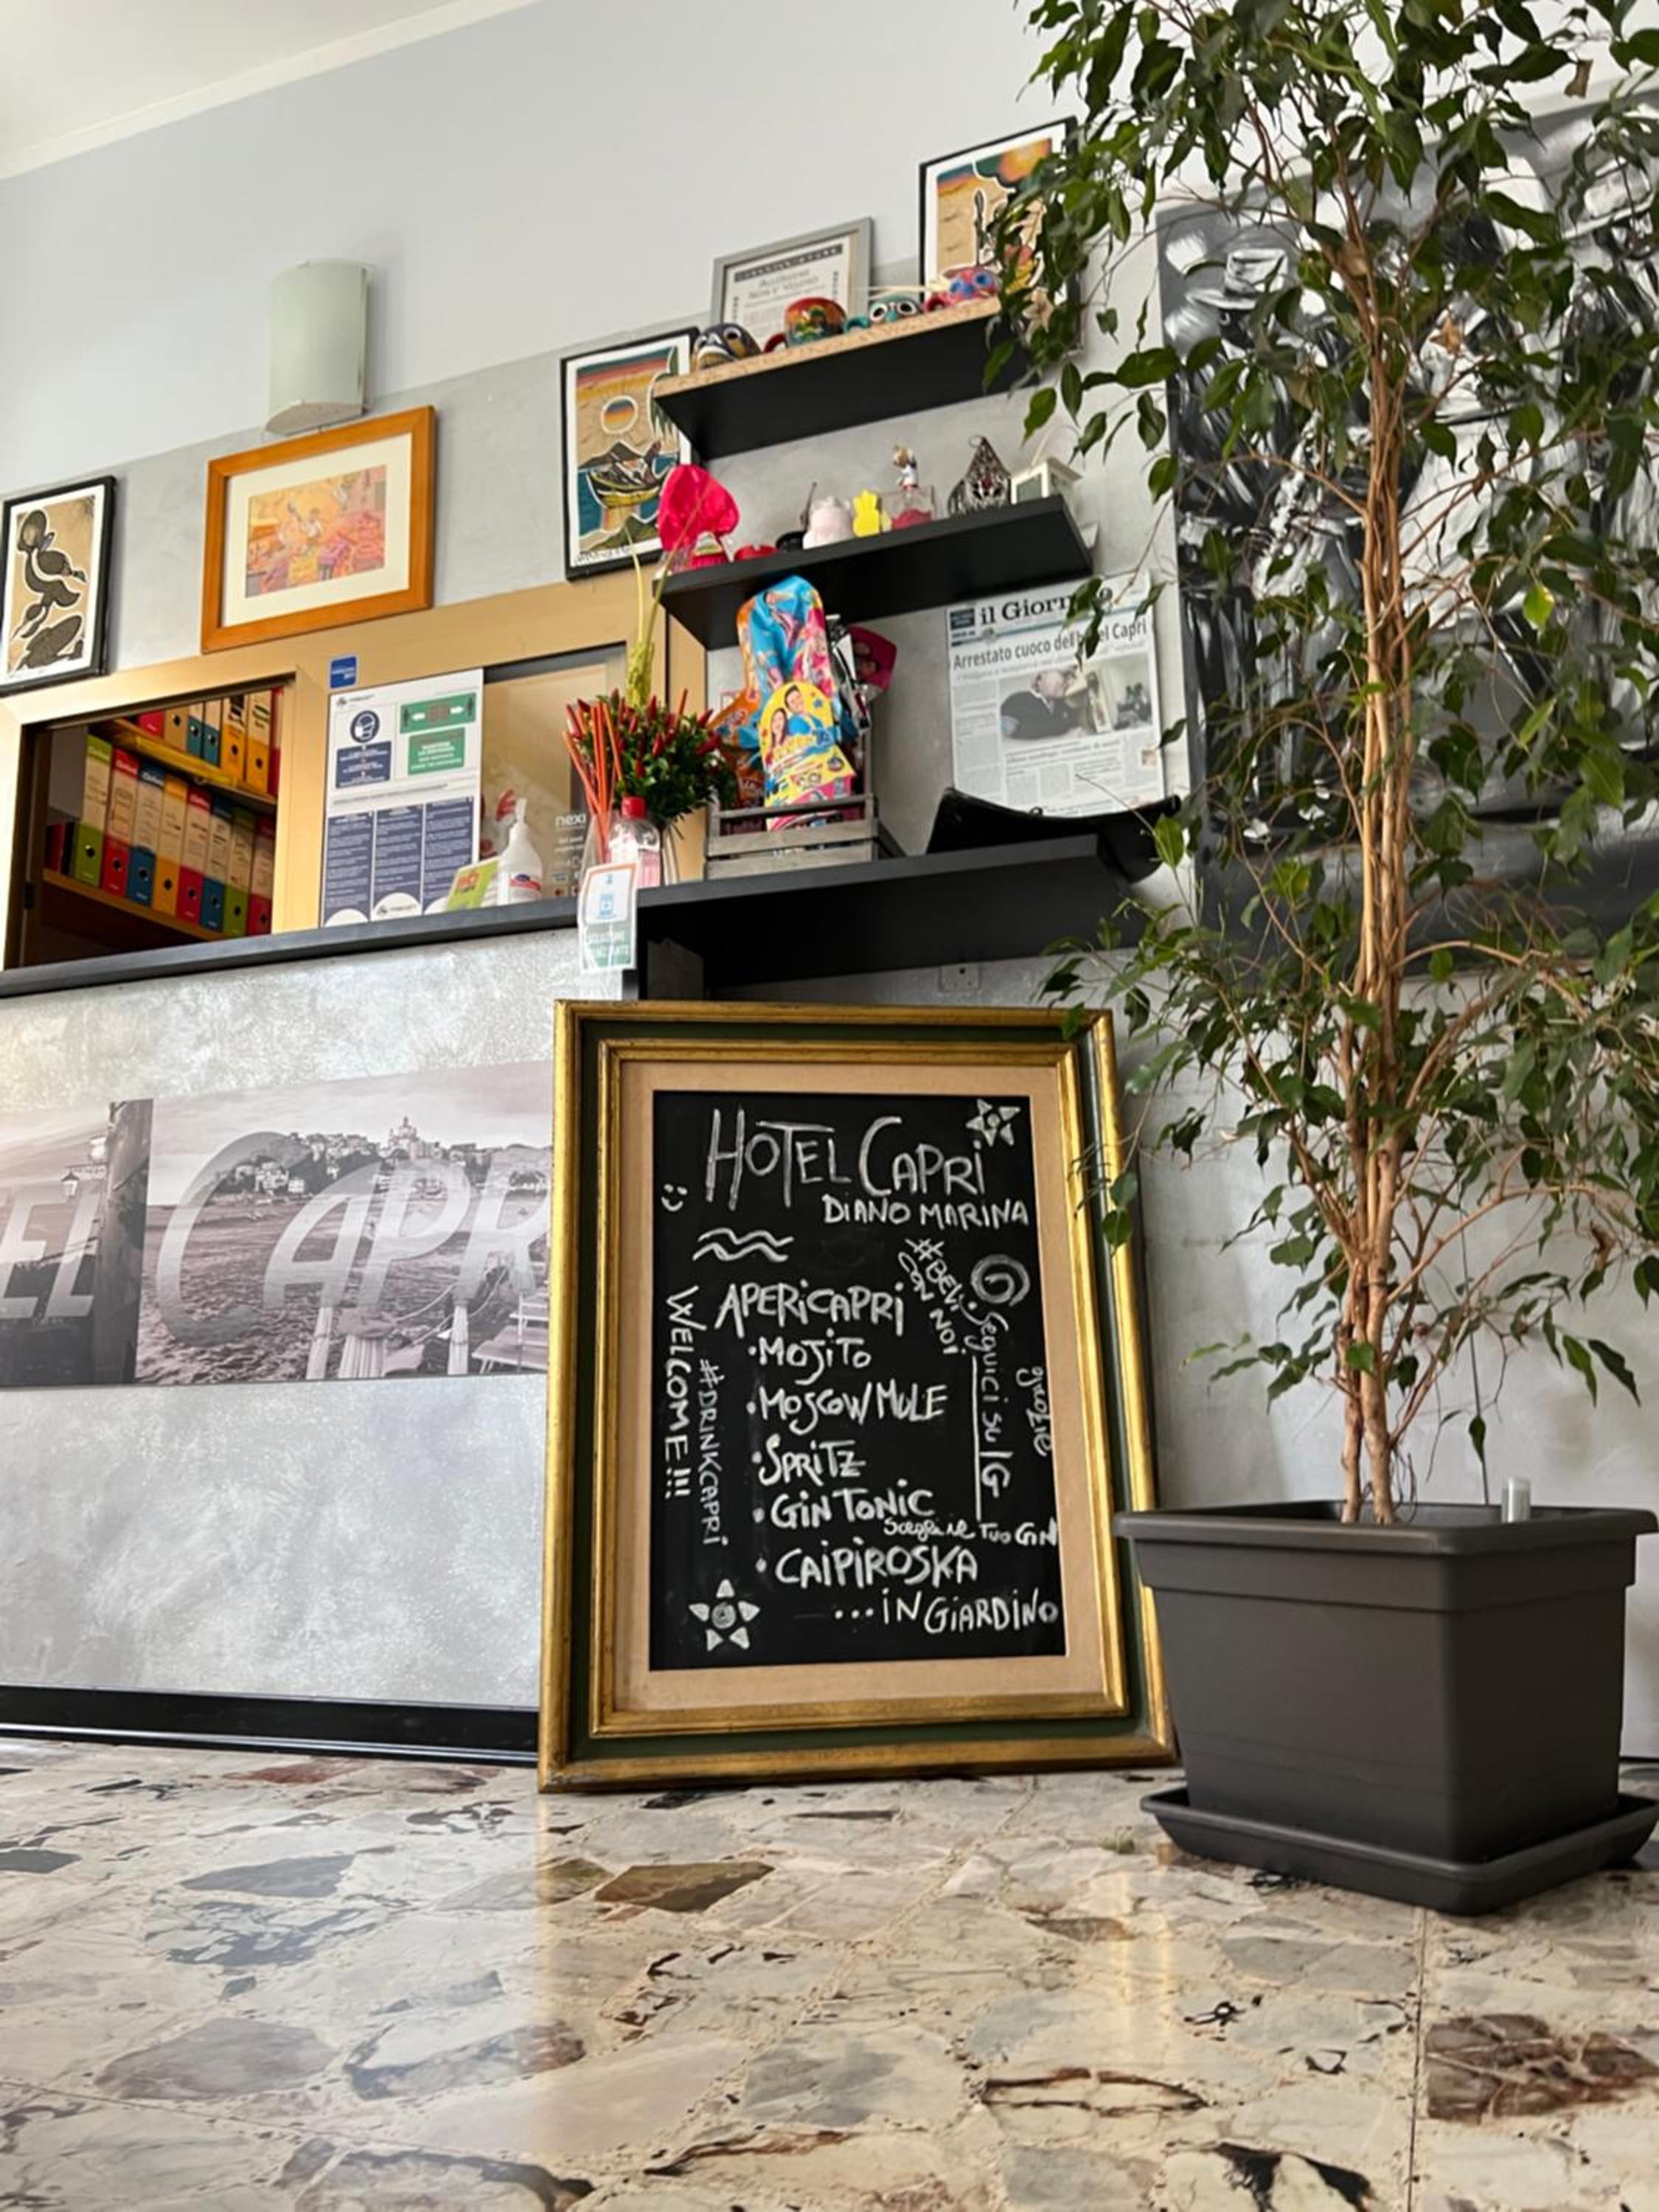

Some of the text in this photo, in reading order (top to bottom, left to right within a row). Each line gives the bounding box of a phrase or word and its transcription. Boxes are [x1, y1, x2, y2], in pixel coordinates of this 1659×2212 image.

[981, 606, 995, 625] il
[953, 647, 1012, 669] Arrestato
[1014, 640, 1051, 658] cuoco
[1112, 618, 1147, 641] Capri
[554, 813, 588, 827] nexi
[705, 1107, 852, 1210] HOTEL
[822, 1193, 1029, 1230] DIANO MARINA
[665, 1285, 708, 1500] WELCOME!!!
[876, 1377, 948, 1422] MULE
[979, 1450, 1014, 1498] IG
